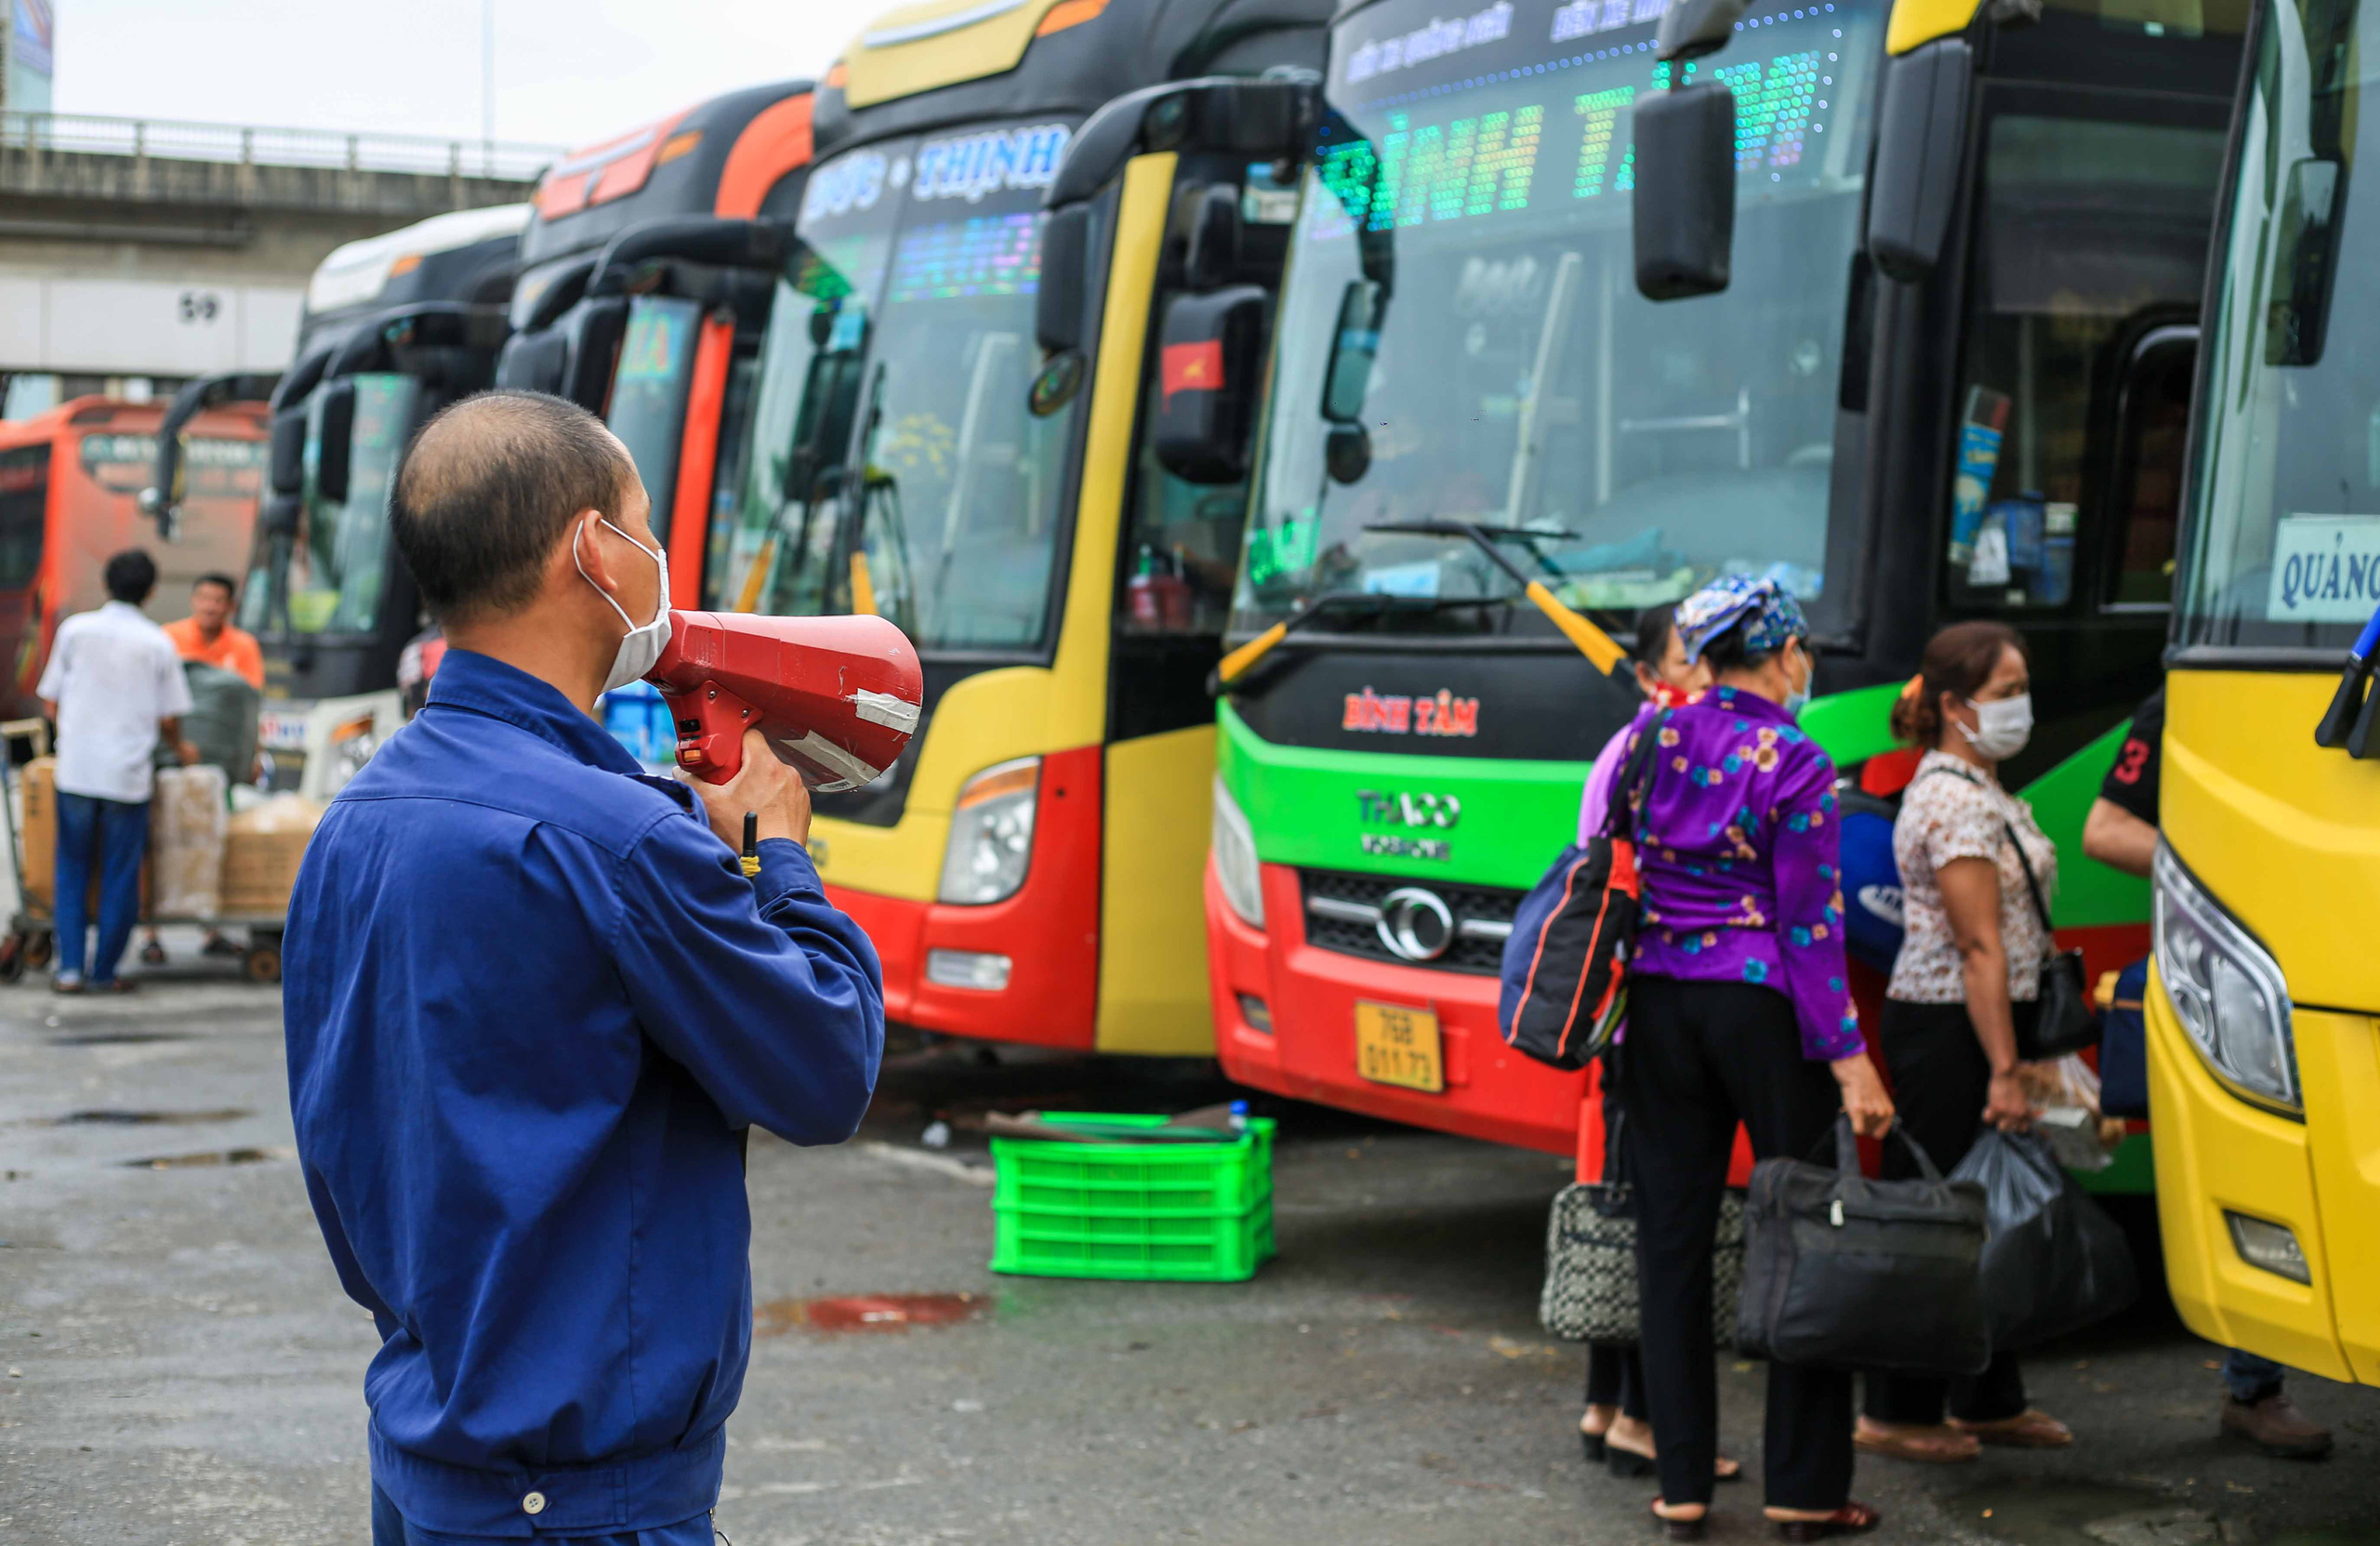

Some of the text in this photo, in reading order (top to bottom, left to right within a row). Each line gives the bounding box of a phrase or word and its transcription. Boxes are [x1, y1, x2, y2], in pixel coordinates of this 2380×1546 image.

[1572, 49, 1821, 198] TM
[2115, 737, 2150, 785] 3
[1355, 787, 1461, 828] THACO
